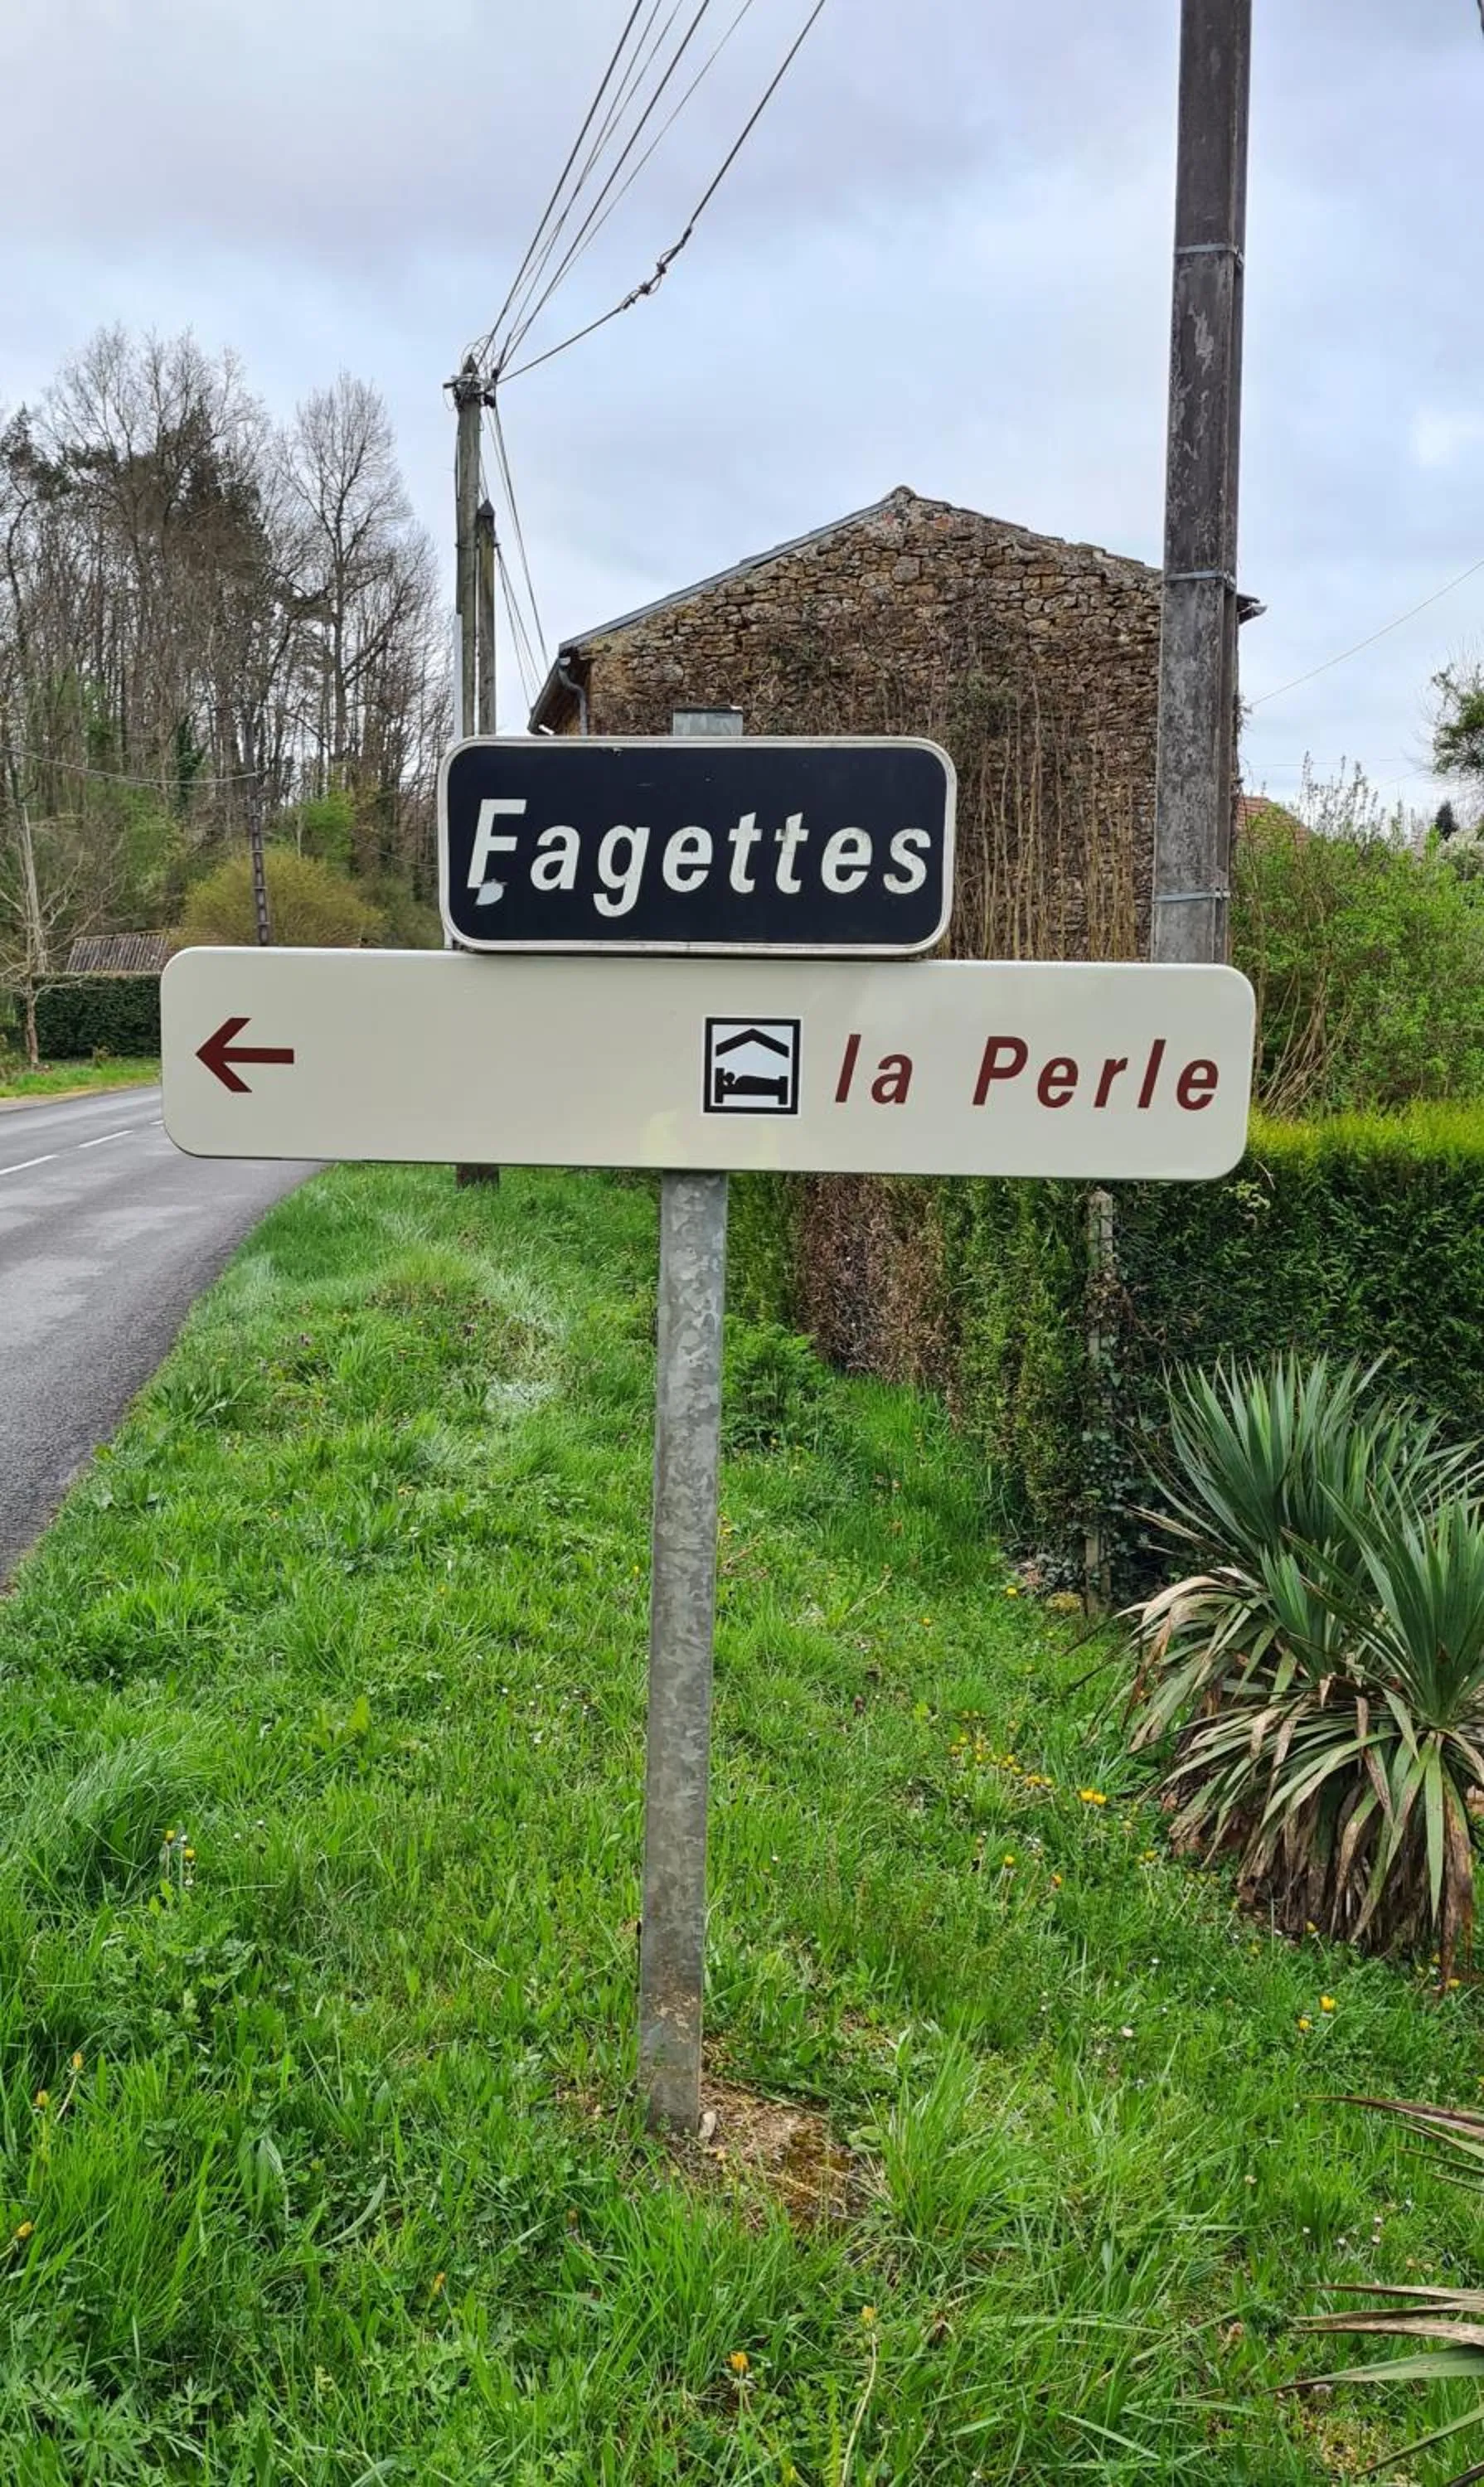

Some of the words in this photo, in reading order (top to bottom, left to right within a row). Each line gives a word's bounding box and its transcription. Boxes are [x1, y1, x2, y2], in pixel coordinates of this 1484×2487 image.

[467, 798, 932, 918] Fagettes
[835, 1034, 914, 1104] la
[972, 1035, 1220, 1111] Perle
